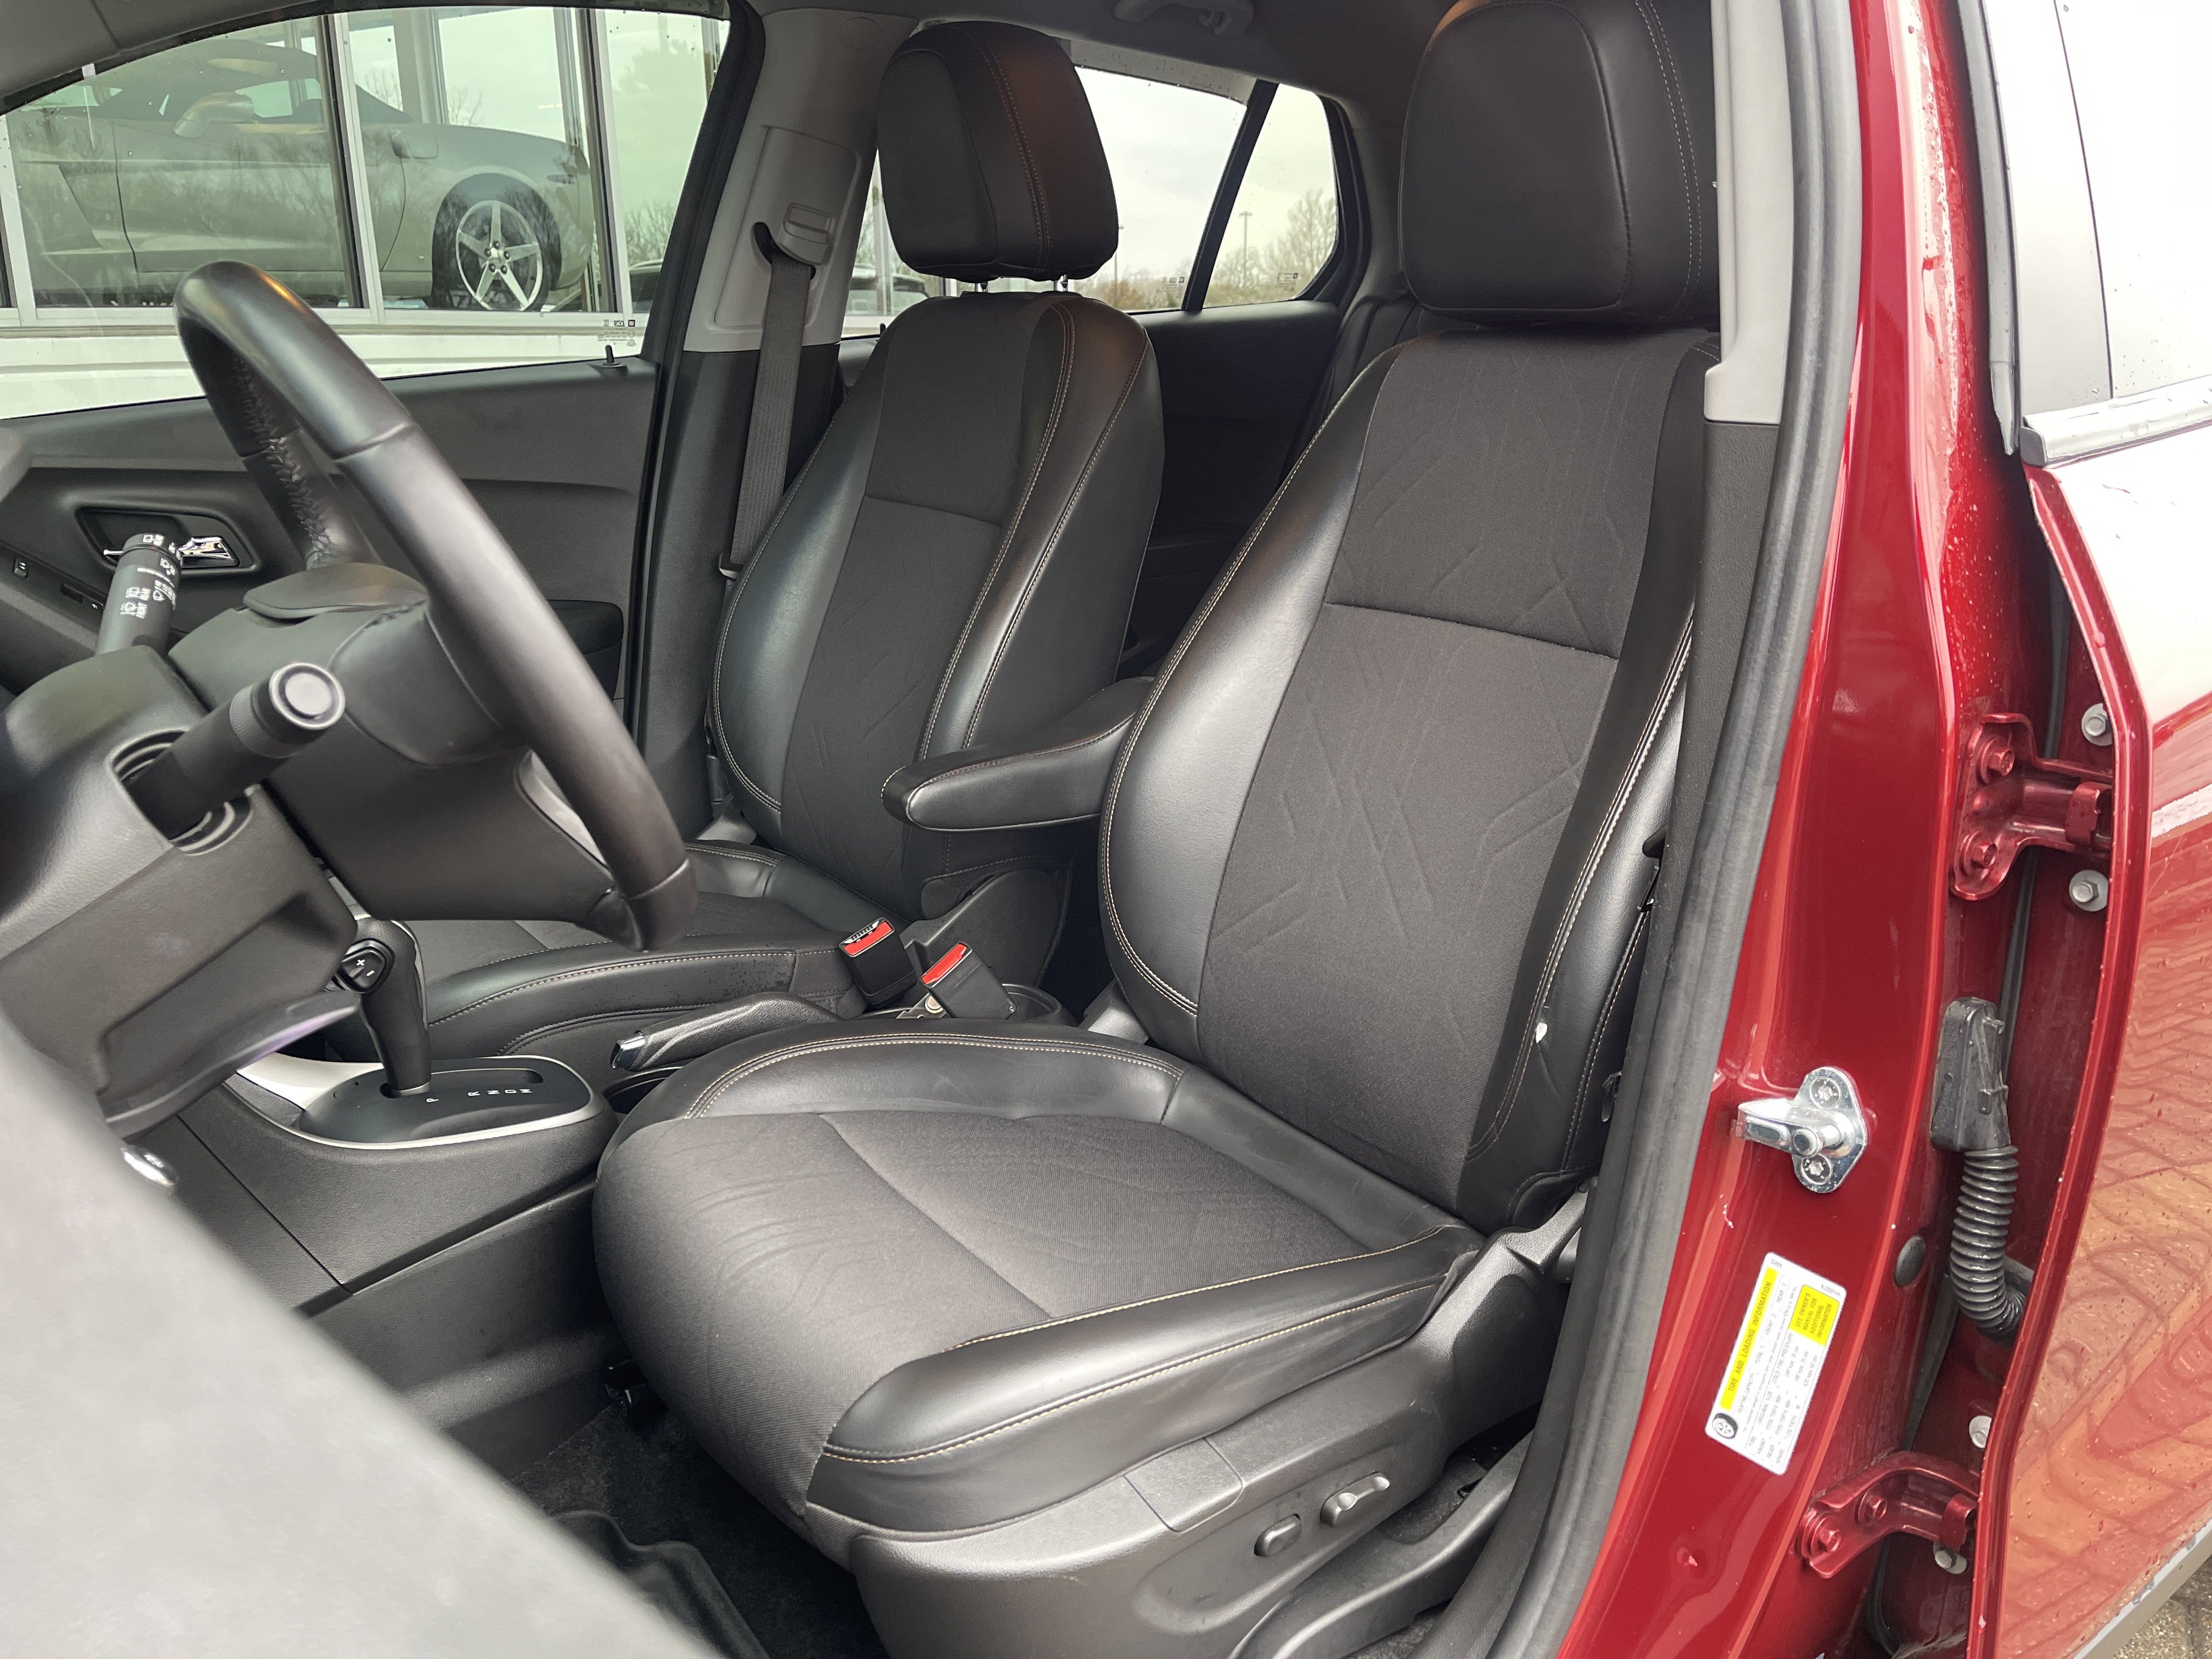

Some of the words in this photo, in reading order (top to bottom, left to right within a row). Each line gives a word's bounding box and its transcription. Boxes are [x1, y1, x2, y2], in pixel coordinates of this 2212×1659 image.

[136, 602, 148, 619] FRONT
[1776, 1289, 1784, 1303] REAR
[1799, 1292, 1810, 1316] OWNER'S
[1765, 1319, 1773, 1335] FRONT
[1802, 1310, 1814, 1330] MANUAL
[1809, 1305, 1824, 1334] ADDITIONAL
[1816, 1304, 1831, 1338] INFORMATION
[1728, 1376, 1738, 1391] TIRE
[1735, 1360, 1743, 1374] AND
[1741, 1329, 1755, 1357] LOADING
[1752, 1282, 1771, 1325] INFORMATION
[1754, 1351, 1763, 1363] TOTAL
[1771, 1370, 1780, 1384] COLD
[1781, 1332, 1793, 1357] PRESSURE
[1737, 1395, 1747, 1413] SEATING
[1744, 1373, 1754, 1394] CAPACITY
[1757, 1403, 1769, 1424] ORIGINAL
[1748, 1436, 1757, 1446] TIRE
[1757, 1438, 1765, 1454] FRONT
[1766, 1444, 1774, 1458] REAR
[1775, 1448, 1785, 1463] SPARE
